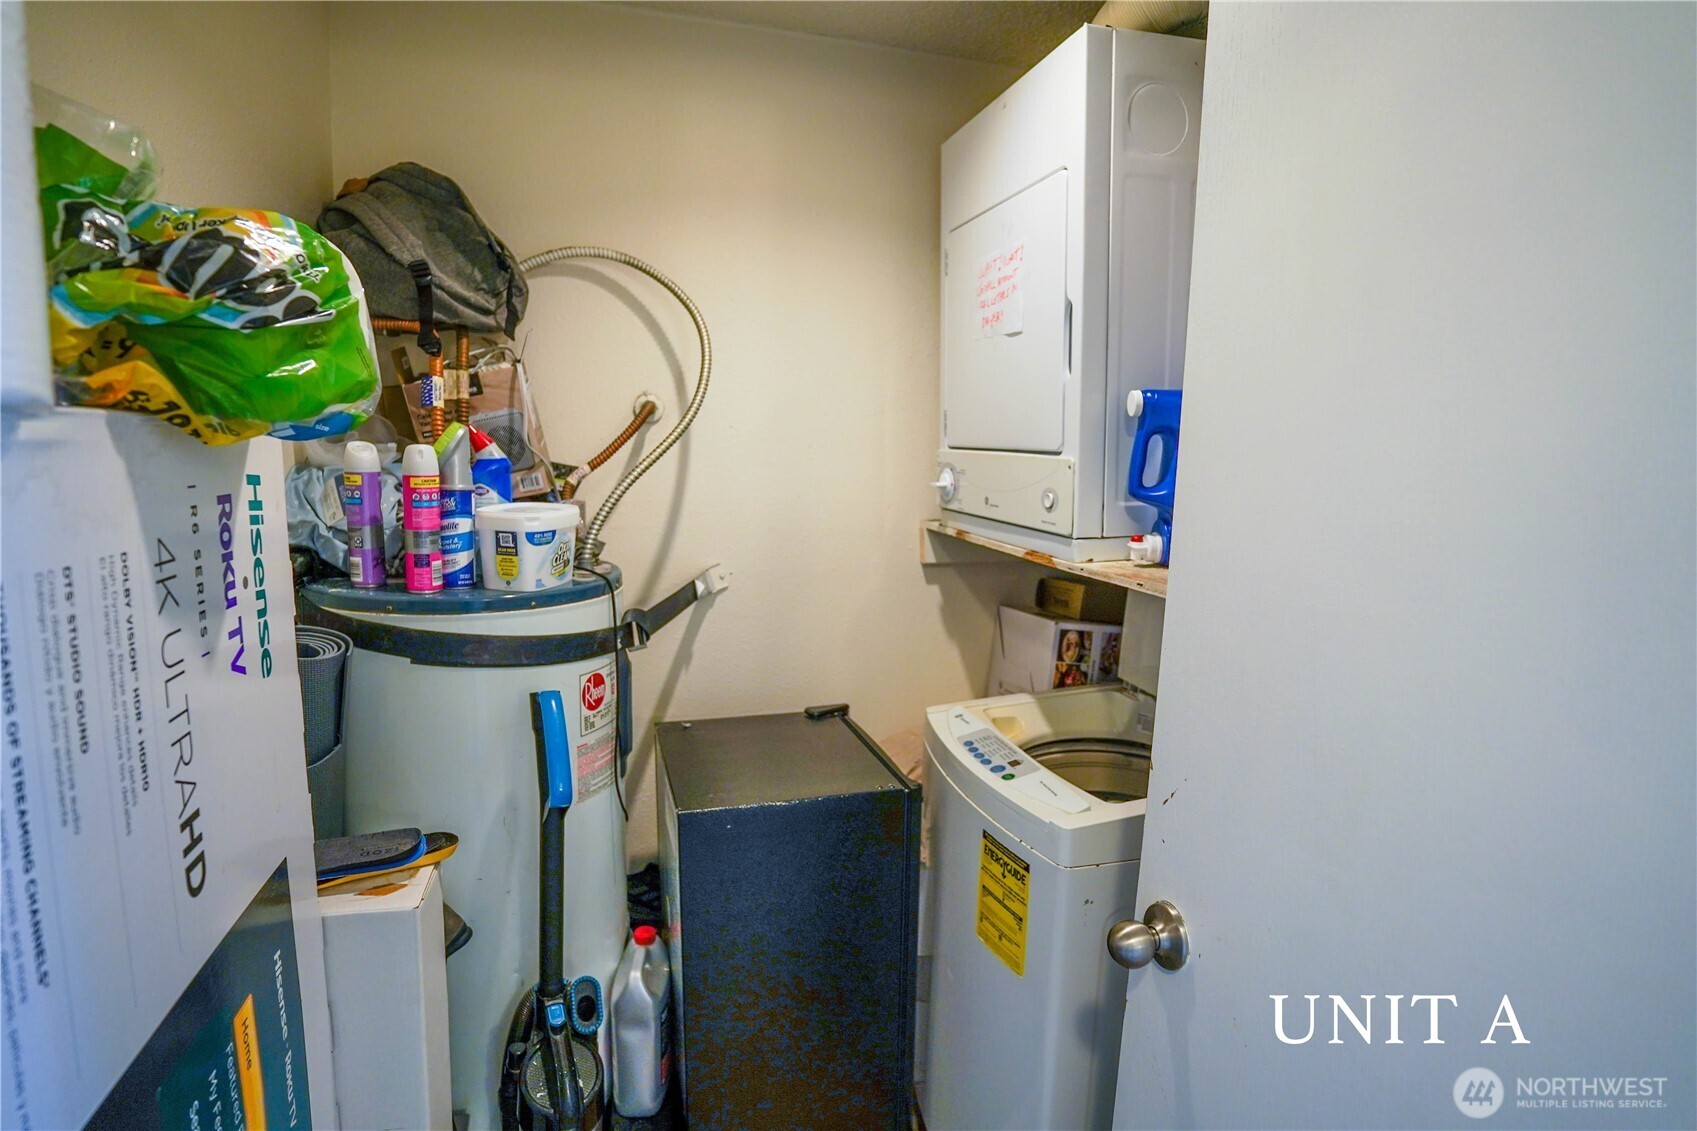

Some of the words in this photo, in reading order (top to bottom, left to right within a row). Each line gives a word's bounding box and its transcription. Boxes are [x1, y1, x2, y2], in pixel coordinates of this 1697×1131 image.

[191, 504, 199, 533] R6
[217, 493, 238, 609] Roku
[154, 538, 180, 615] 4K
[193, 549, 207, 638] SERIES
[245, 473, 273, 679] Hisense
[65, 613, 83, 685] STUDIO
[74, 688, 90, 754] SOUND
[118, 551, 132, 609] DOLBY
[132, 685, 142, 723] HDR
[138, 739, 150, 792] HDR10
[227, 616, 247, 675] TV
[585, 675, 605, 707] Rheem
[6, 719, 22, 753] OF
[8, 755, 35, 875] STREAMING
[273, 949, 288, 1041] Hisense
[208, 1068, 218, 1101] My
[225, 1041, 243, 1125] Featured
[241, 1017, 253, 1071] Home
